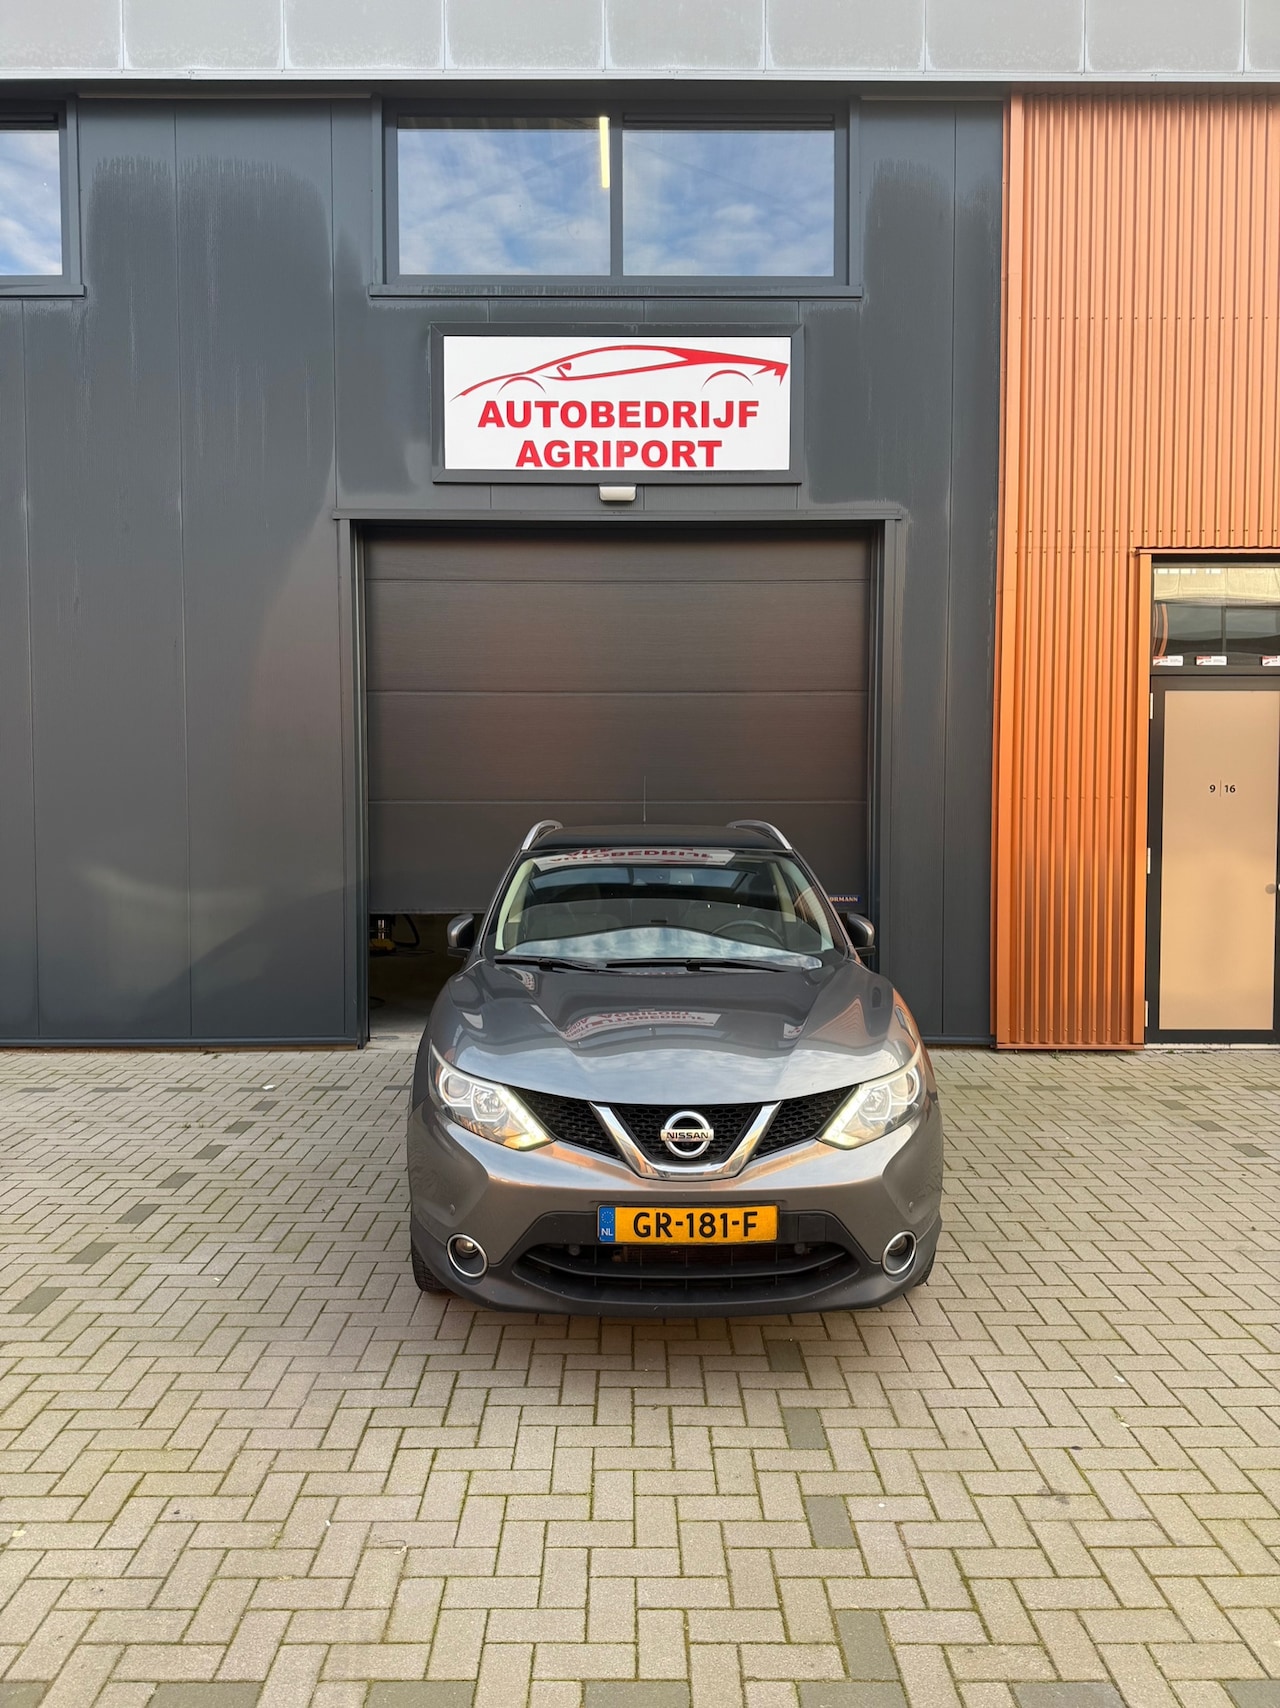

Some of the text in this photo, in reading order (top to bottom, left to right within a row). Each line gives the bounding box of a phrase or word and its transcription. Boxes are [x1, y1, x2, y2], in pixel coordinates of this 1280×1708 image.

[478, 401, 758, 428] AUTOBEDRIJF
[516, 441, 722, 468] AGRIPORT
[1209, 784, 1236, 793] 9 16
[666, 1131, 709, 1139] NISSAN
[601, 1211, 758, 1238] NL GR-181-F
